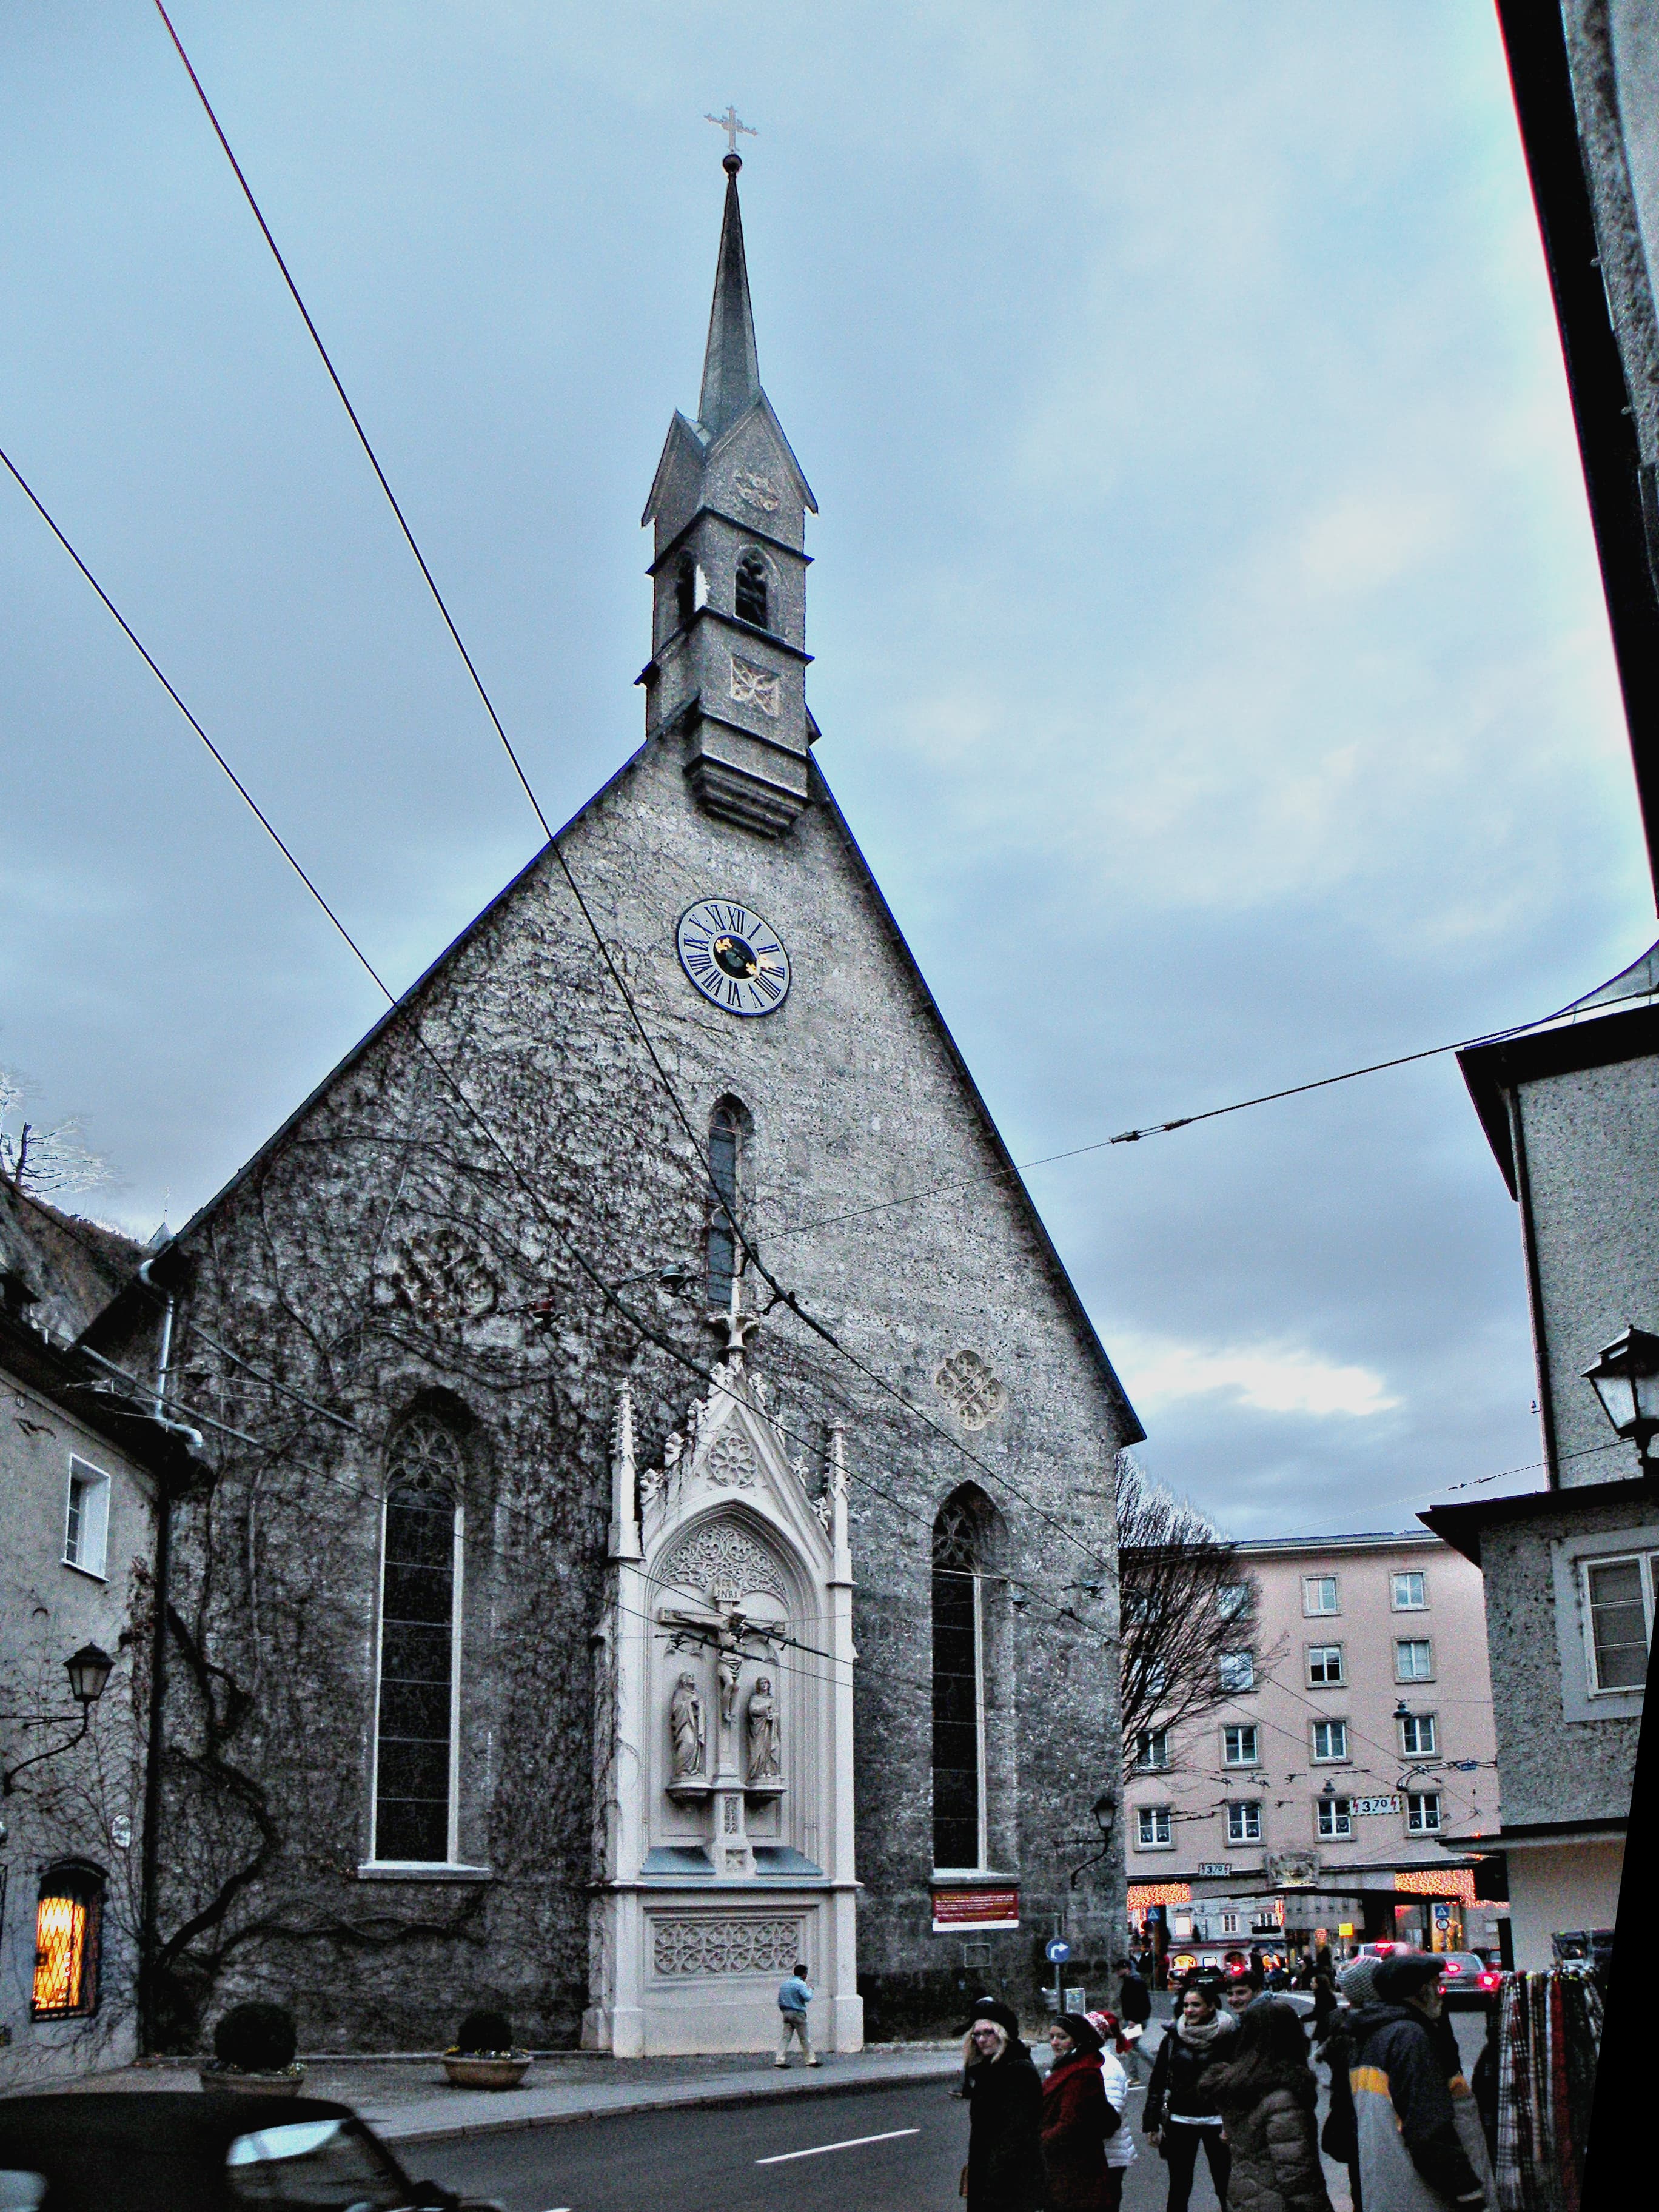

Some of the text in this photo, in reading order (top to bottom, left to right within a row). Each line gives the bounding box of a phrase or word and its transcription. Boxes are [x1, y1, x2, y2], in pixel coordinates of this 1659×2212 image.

[688, 914, 714, 939] X
[726, 905, 746, 935] XII
[747, 922, 762, 940] I
[757, 943, 781, 954] II
[748, 983, 765, 1009] V
[717, 1589, 737, 1598] INRI
[1362, 1799, 1388, 1812] 3.70
[1207, 1865, 1223, 1874] 3.70
